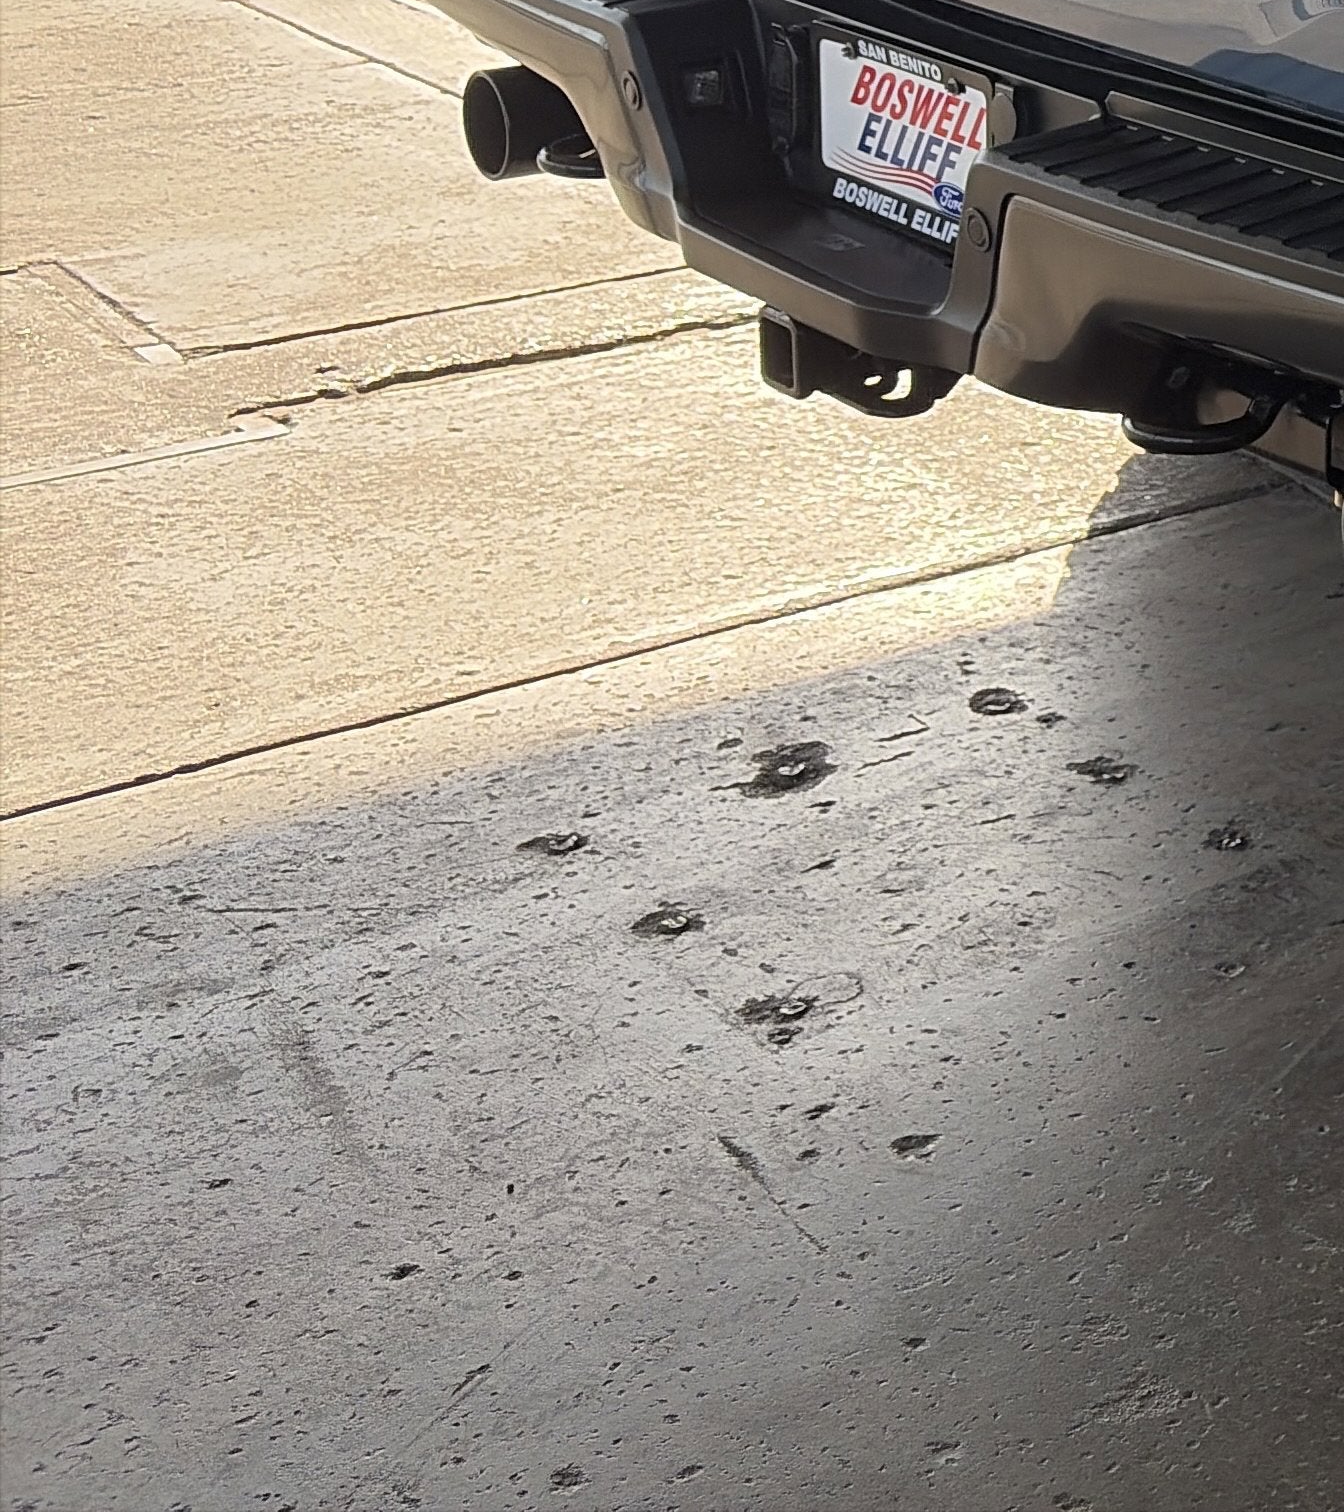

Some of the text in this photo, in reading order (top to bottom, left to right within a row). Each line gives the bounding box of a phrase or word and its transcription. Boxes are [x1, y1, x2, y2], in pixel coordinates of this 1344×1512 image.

[857, 39, 942, 81] SAN BENITO
[850, 64, 987, 151] BOSWELL
[857, 111, 963, 183] ELLIFF
[832, 177, 960, 244] BOSWELL ELLIF
